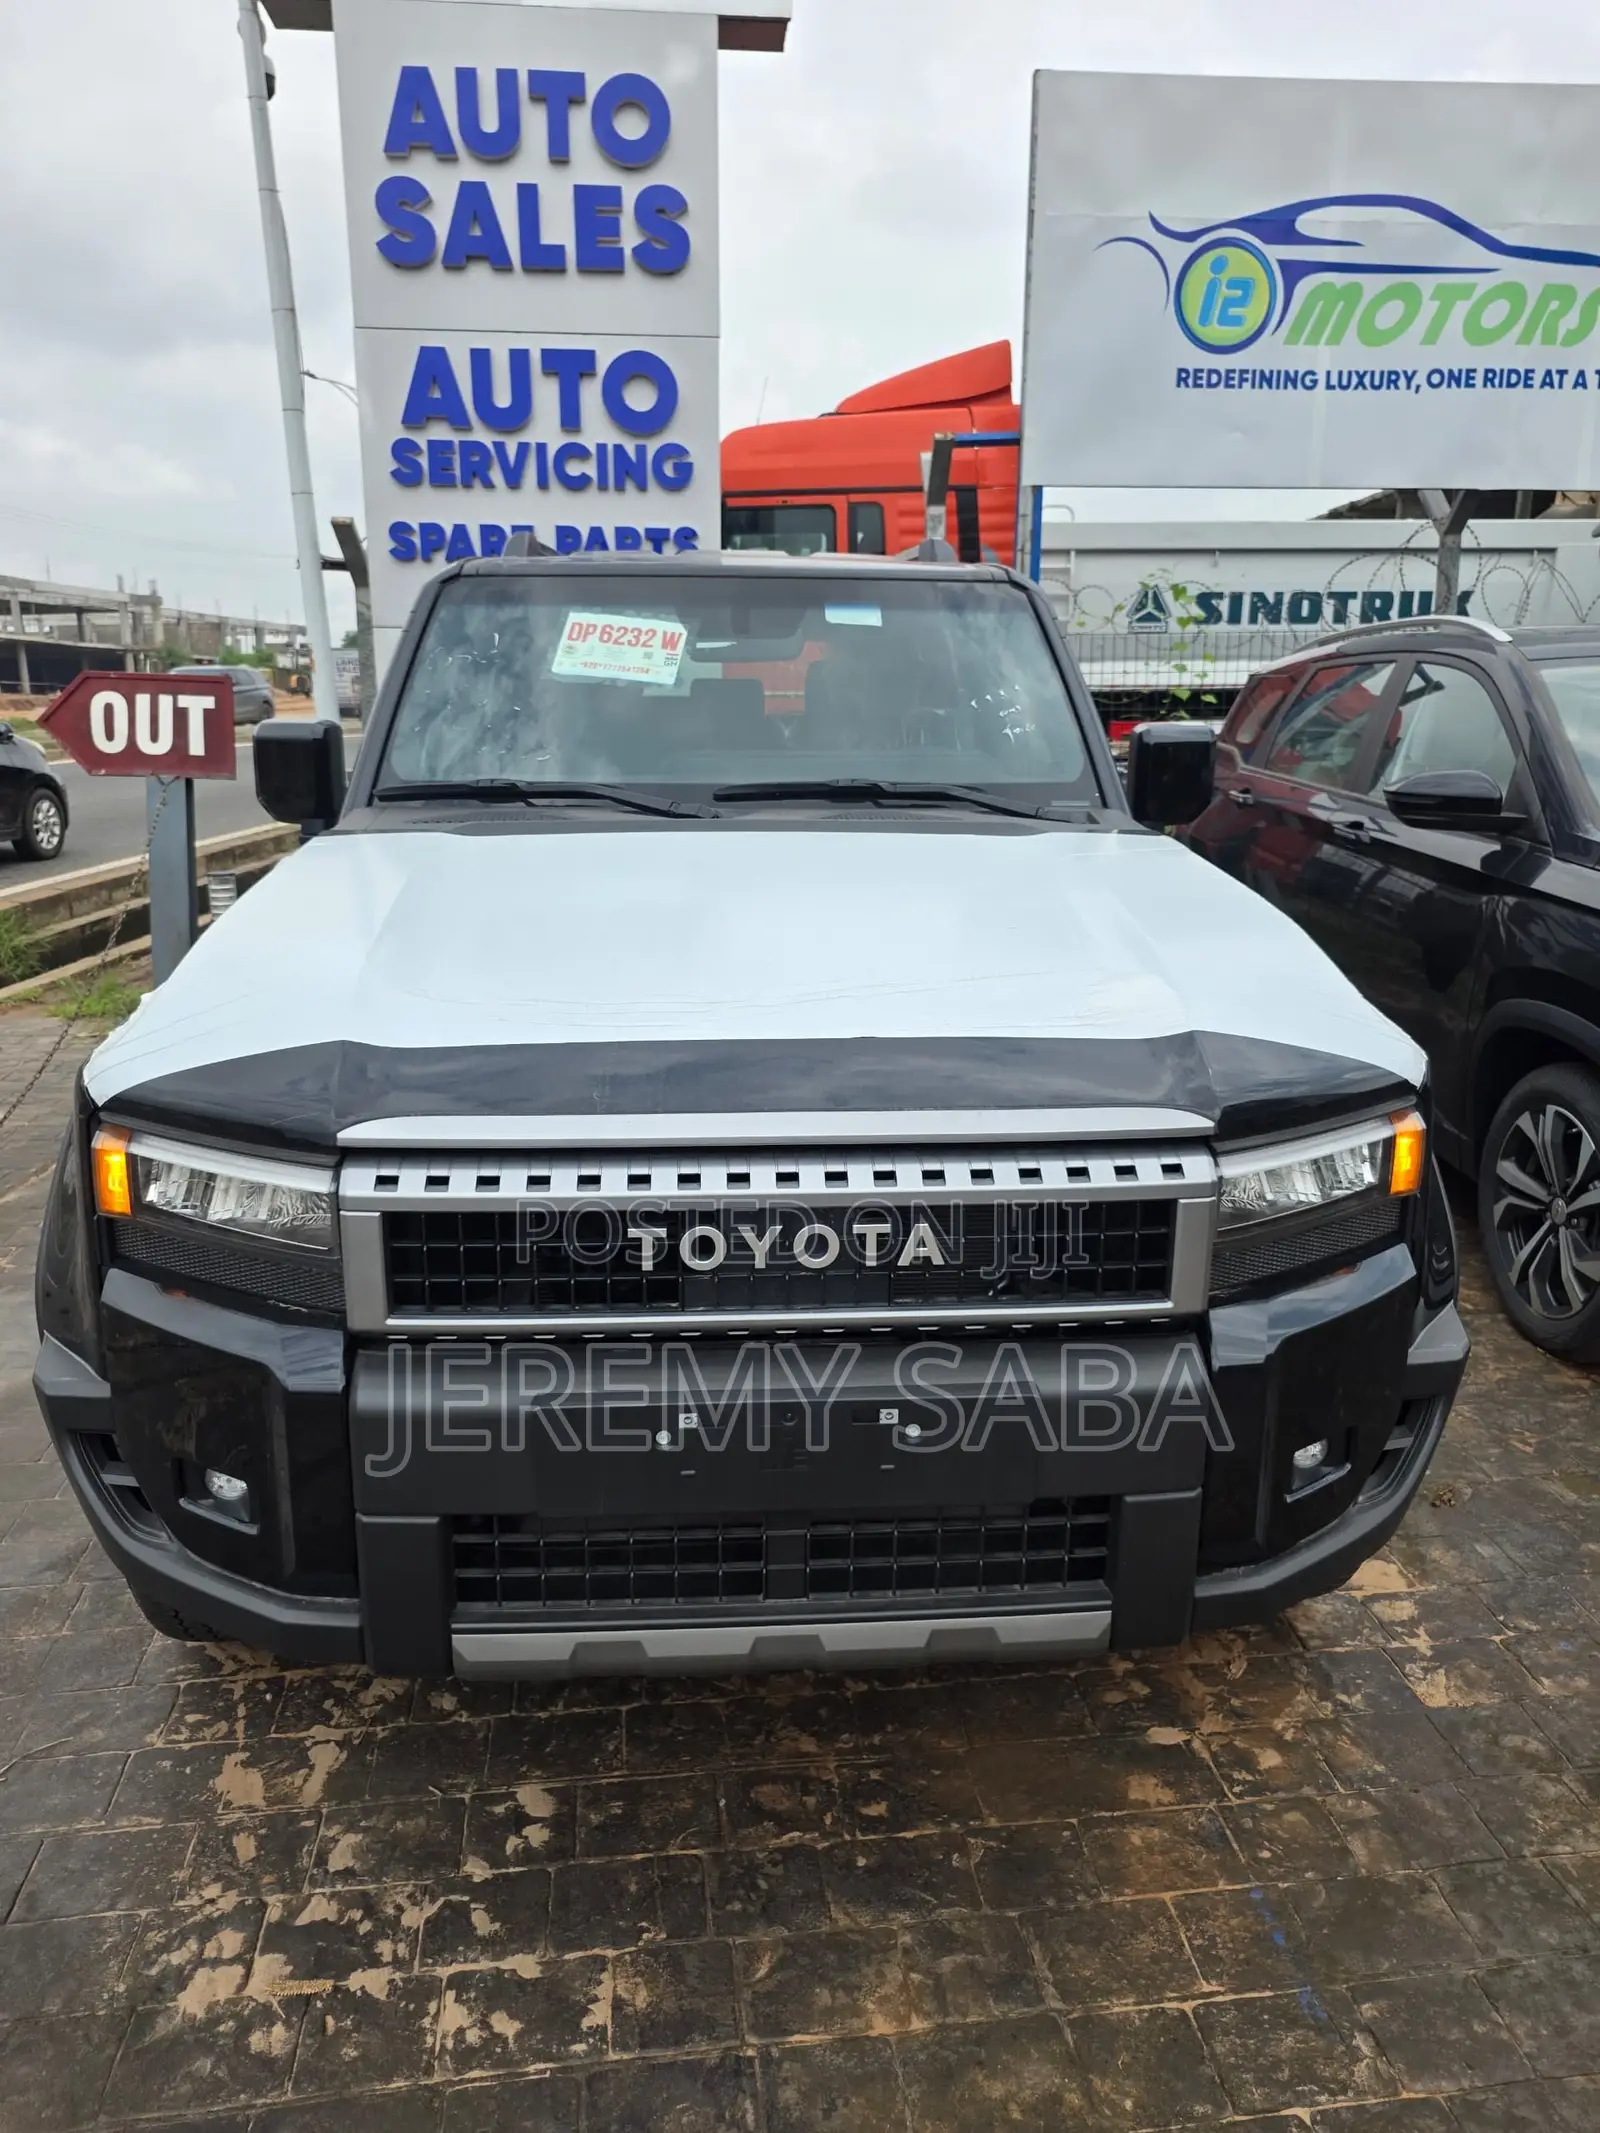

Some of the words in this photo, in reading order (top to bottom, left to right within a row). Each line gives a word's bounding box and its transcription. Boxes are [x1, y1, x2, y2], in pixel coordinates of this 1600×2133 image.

[384, 65, 671, 170] AUTO
[375, 175, 691, 275] SALES
[1282, 280, 1600, 348] MOTORS
[401, 345, 679, 436] AUTO
[1175, 367, 1319, 391] REDEFINING
[1325, 369, 1422, 394] LUXURY,
[1426, 367, 1478, 389] ONE
[1483, 367, 1536, 389] RIDE
[1540, 368, 1569, 389] AT
[1571, 368, 1589, 389] A
[389, 437, 695, 492] SERVICING
[388, 520, 535, 564] SPAR
[89, 690, 216, 756] OUT
[627, 1222, 945, 1272] TOYOTA
